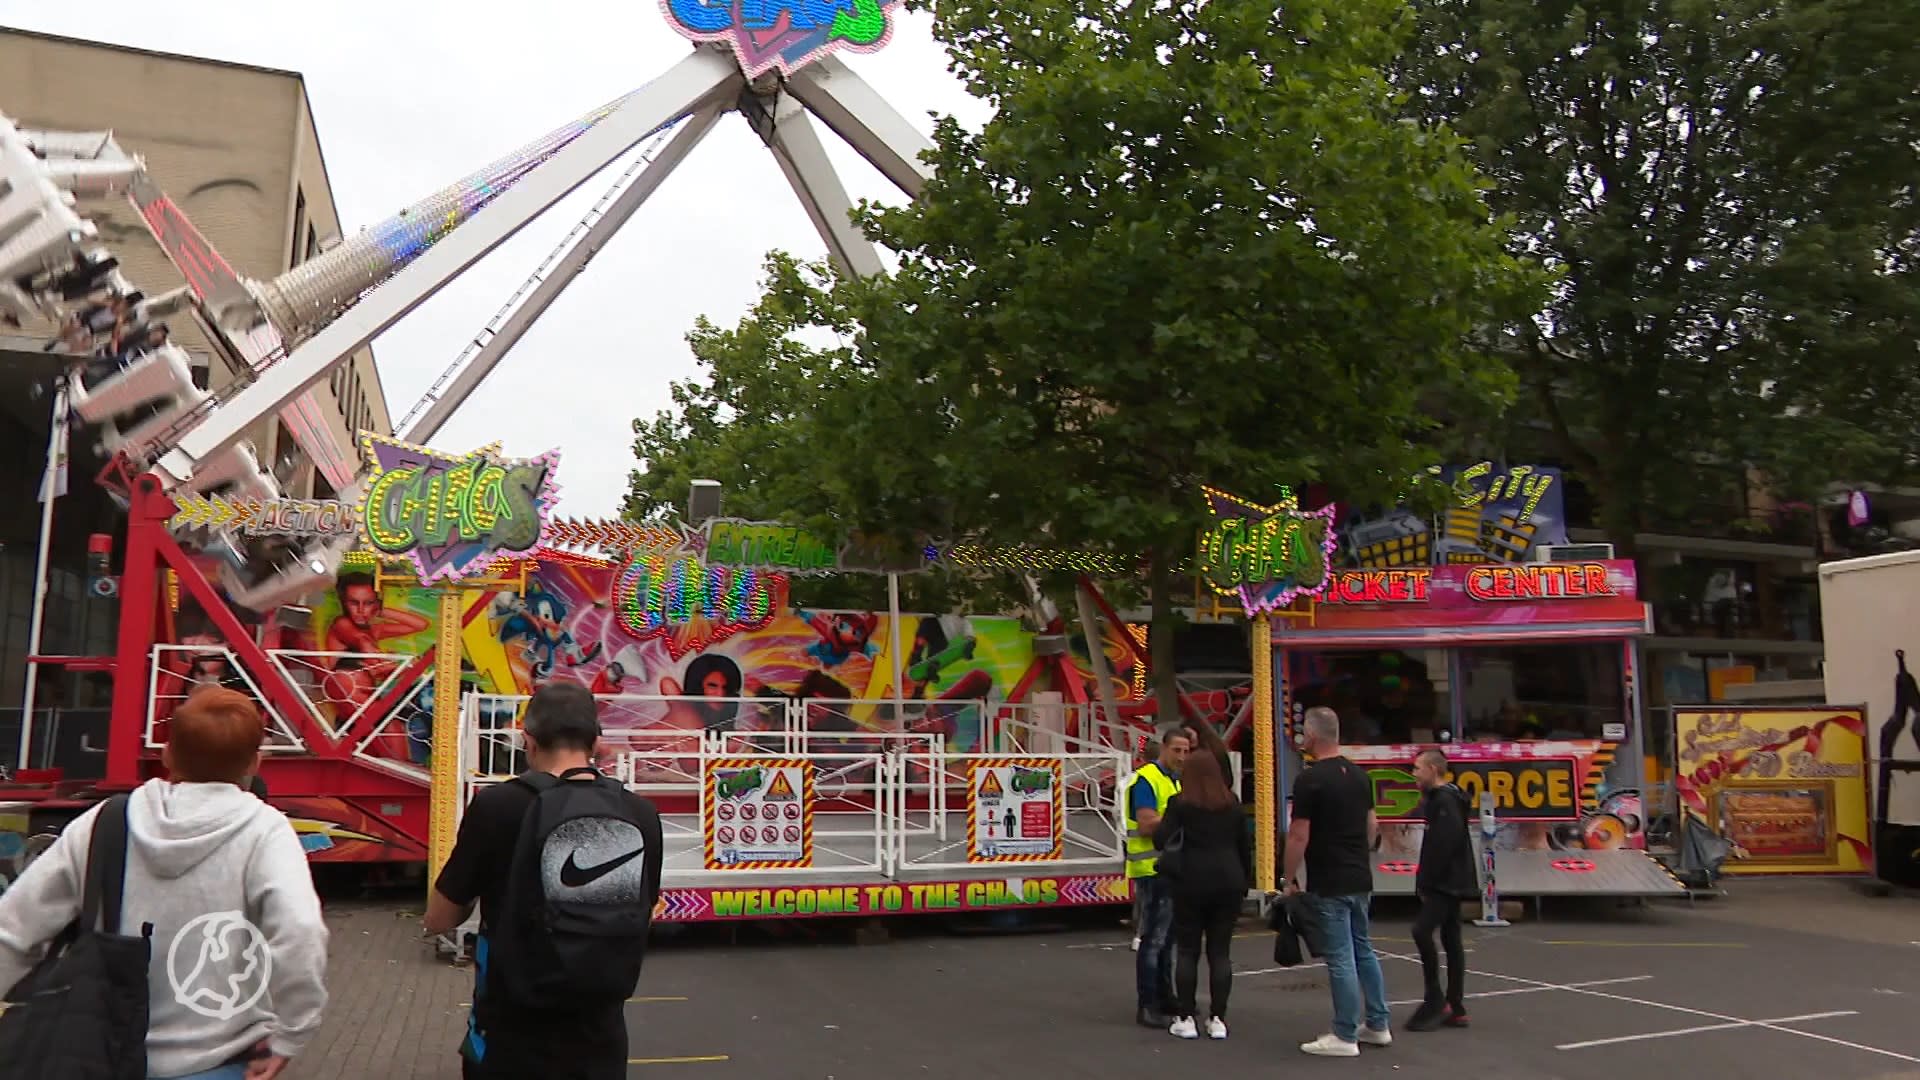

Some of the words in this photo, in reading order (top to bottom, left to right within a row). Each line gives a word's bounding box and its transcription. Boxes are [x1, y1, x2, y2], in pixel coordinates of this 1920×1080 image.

[257, 501, 355, 533] ACTION
[365, 460, 546, 554] CHAOS
[1208, 514, 1328, 587] CHAOS
[1313, 569, 1431, 602] ICKET
[1467, 563, 1618, 599] CENTER
[1443, 769, 1573, 809] ORCE
[711, 887, 861, 917] WELCOME
[864, 885, 903, 911] TO
[908, 882, 961, 909] THE
